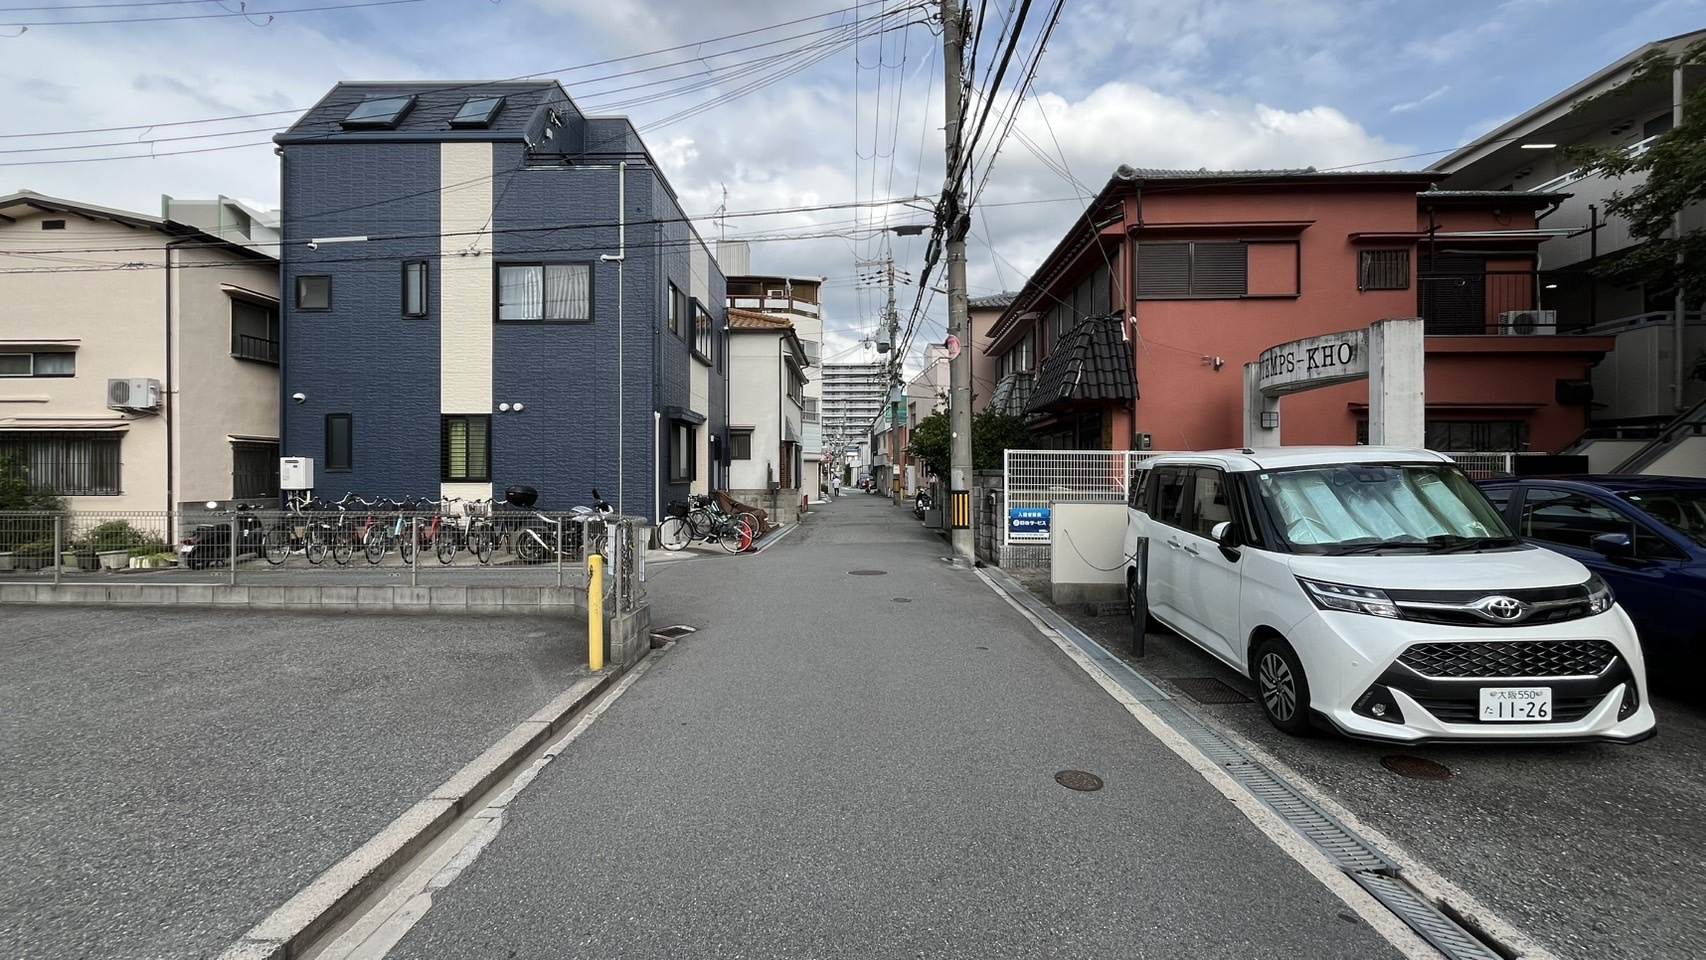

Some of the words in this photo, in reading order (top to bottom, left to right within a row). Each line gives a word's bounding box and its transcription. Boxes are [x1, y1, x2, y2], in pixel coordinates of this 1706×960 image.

[1259, 342, 1353, 381] TEMPS-KHO
[1484, 706, 1493, 715] た
[1499, 701, 1547, 718] 11-26
